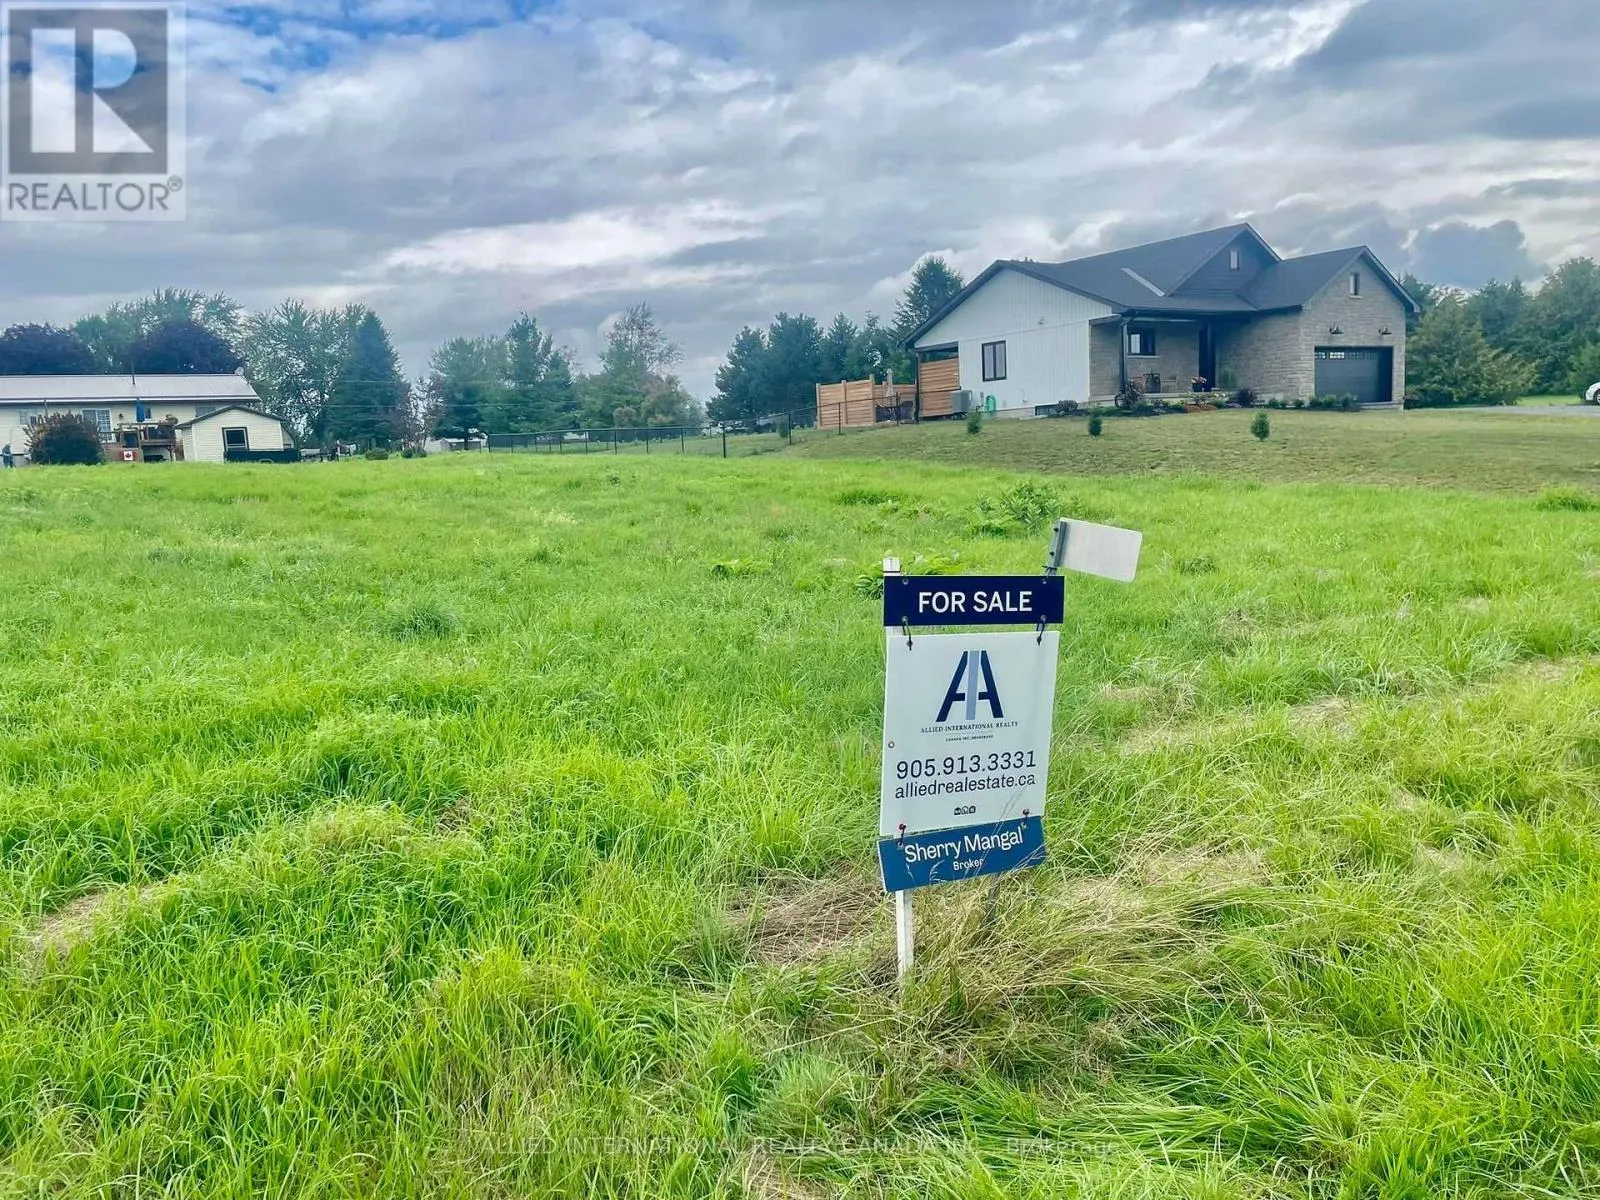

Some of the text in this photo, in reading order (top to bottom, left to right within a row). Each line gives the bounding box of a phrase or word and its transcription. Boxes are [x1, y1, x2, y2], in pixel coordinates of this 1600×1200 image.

[918, 590, 1033, 614] FOR SALE
[945, 722, 993, 732] INTERNATIONAL
[995, 721, 1019, 729] REALTY
[896, 750, 1036, 779] 905.913.3331
[895, 773, 1036, 799] alliedrealestate.ca
[904, 826, 1024, 863] Sherry Mangal
[952, 858, 984, 871] Broker
